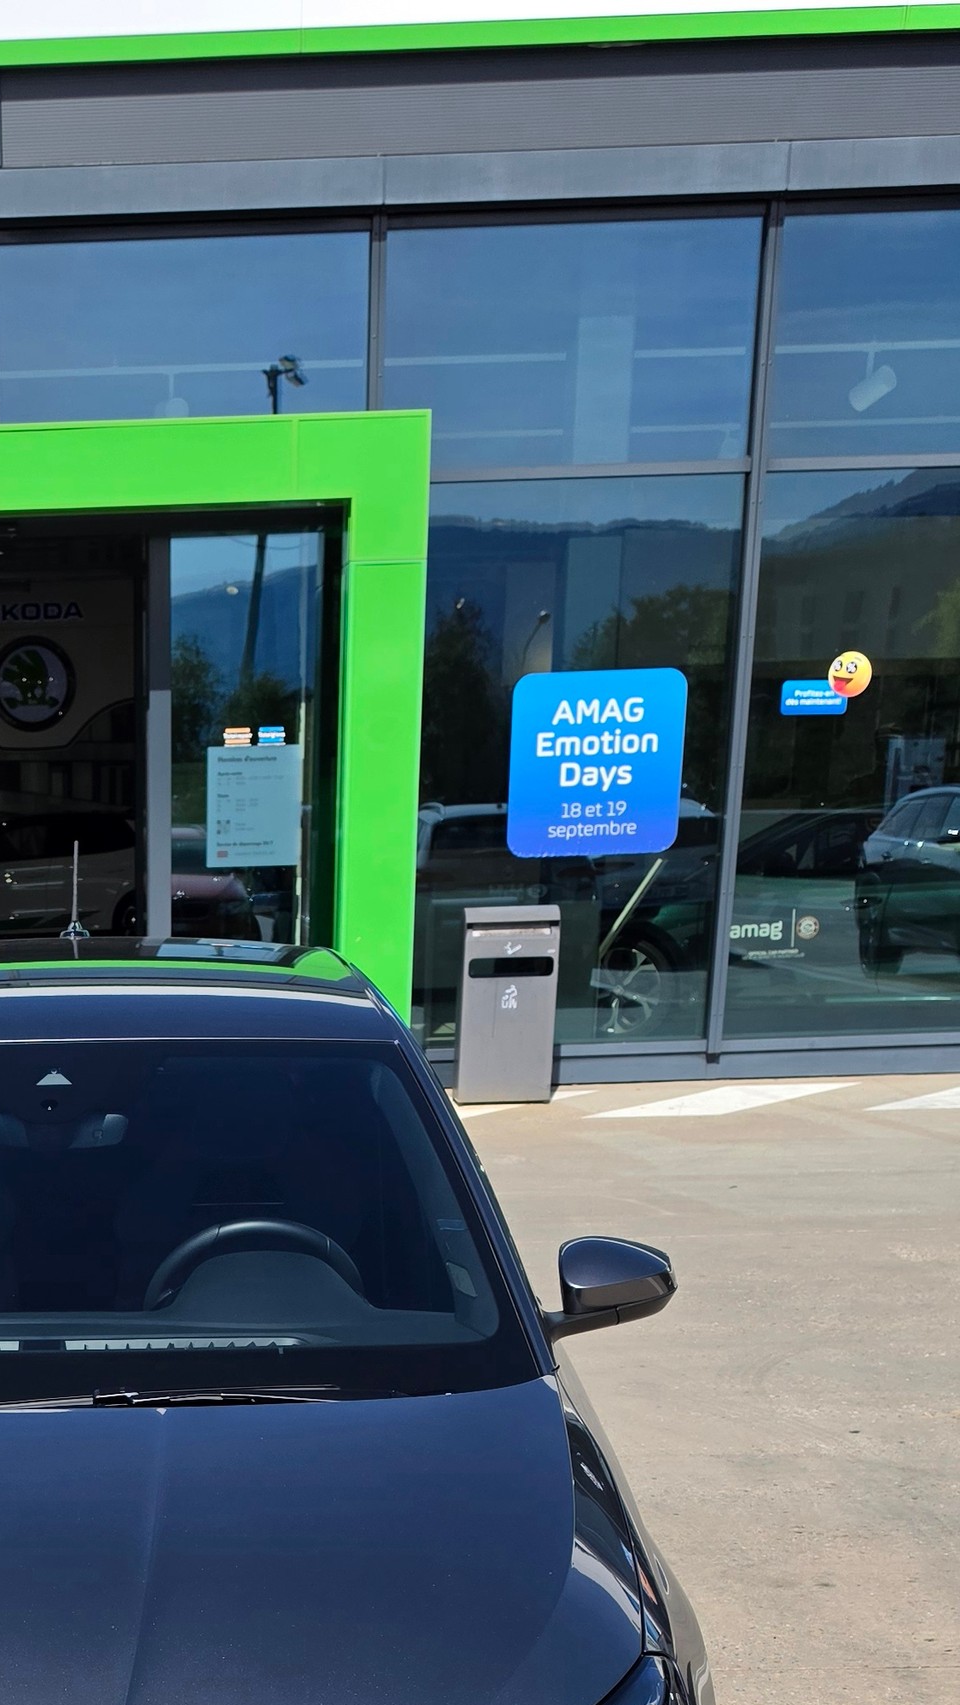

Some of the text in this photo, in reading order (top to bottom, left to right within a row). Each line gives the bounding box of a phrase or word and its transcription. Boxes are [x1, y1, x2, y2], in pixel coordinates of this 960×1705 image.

[551, 696, 644, 725] AMAG
[536, 728, 659, 757] Emotion
[559, 762, 633, 792] Days
[561, 800, 627, 818] 18 et 19
[547, 821, 637, 841] septembre
[729, 920, 783, 940] amag
